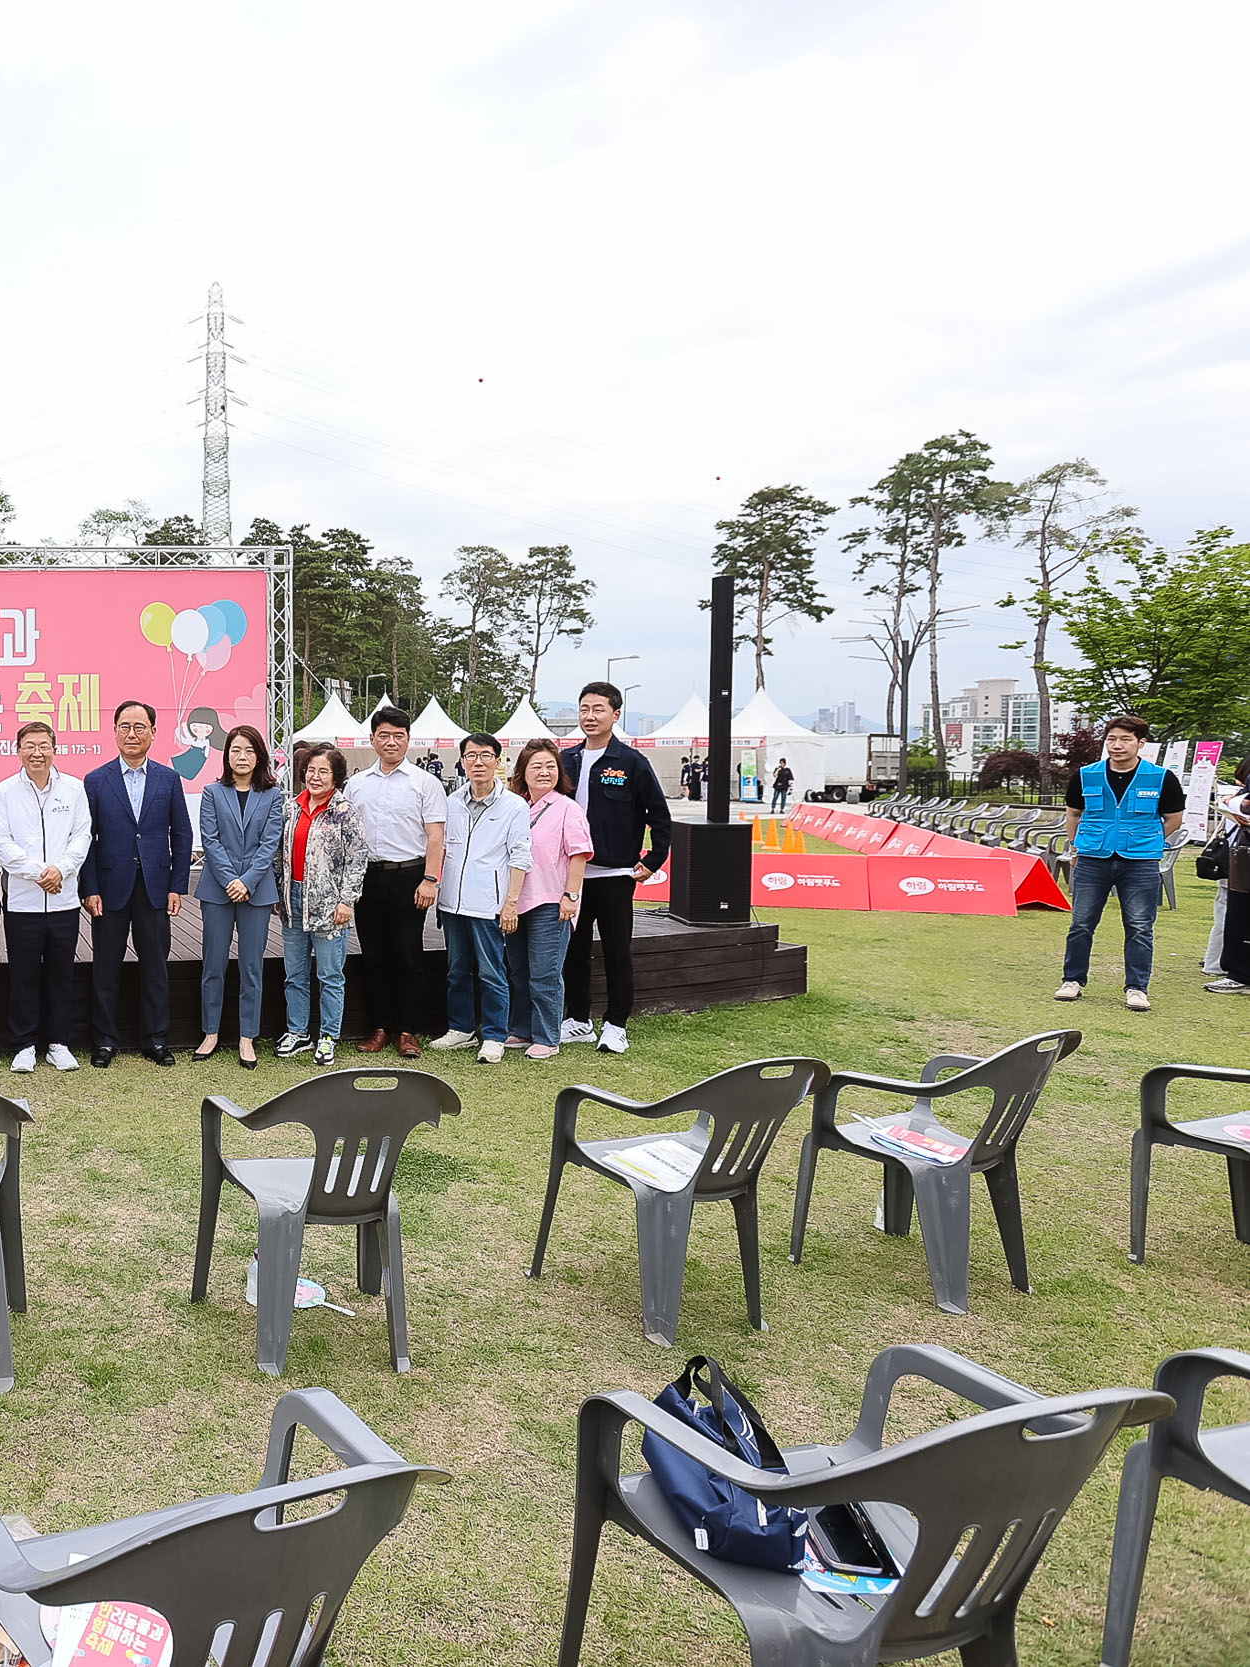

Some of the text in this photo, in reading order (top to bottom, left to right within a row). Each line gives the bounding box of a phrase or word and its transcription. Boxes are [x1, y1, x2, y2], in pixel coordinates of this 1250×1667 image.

[15, 672, 101, 732] 축제
[71, 744, 102, 755] 175-1)
[768, 876, 787, 886] 하림
[906, 881, 927, 891] 하림
[98, 1601, 165, 1642] 반려동물과
[85, 1632, 115, 1657] 축제
[91, 1616, 147, 1653] 함께하는
